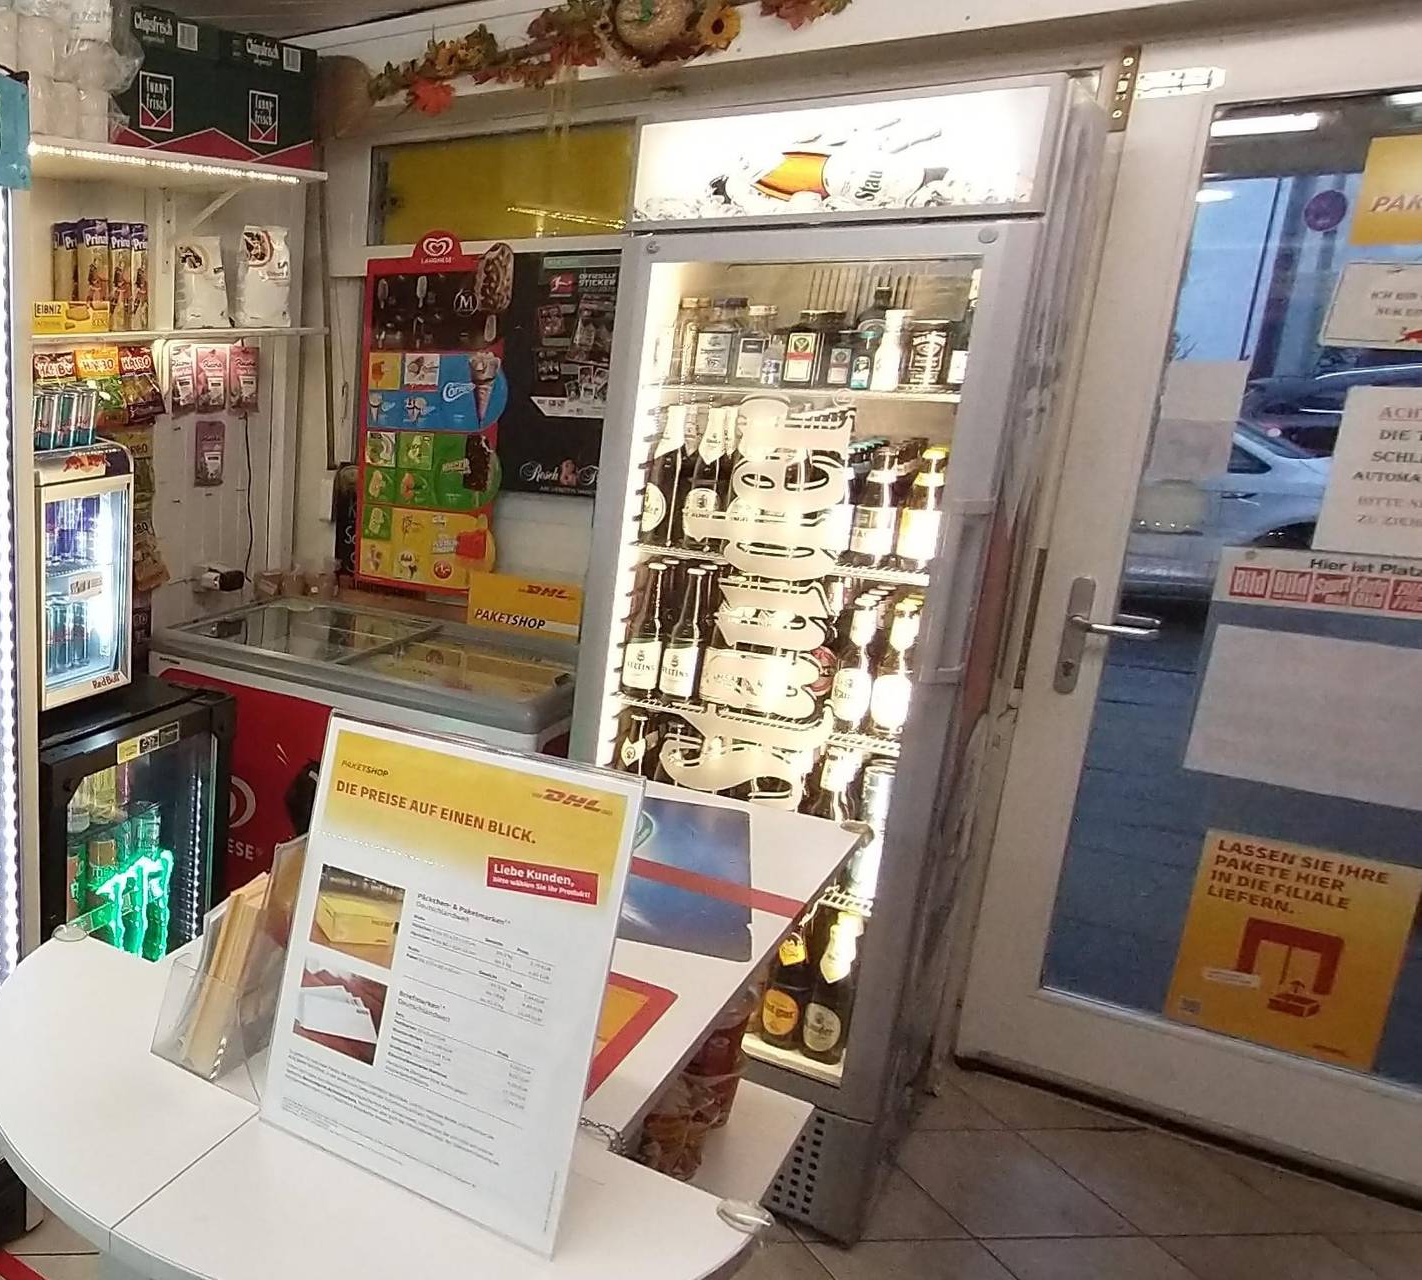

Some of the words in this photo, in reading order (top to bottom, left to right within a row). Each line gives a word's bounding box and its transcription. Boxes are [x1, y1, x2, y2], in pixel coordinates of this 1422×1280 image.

[134, 11, 173, 36] Chipsfrisch
[854, 169, 884, 202] Stau
[578, 278, 617, 288] STICKER
[122, 355, 152, 369] HARIBO
[1379, 429, 1411, 441] DIE
[1352, 471, 1422, 483] AUTOMA
[1310, 558, 1347, 571] Hier
[1352, 561, 1375, 573] ist
[524, 584, 568, 599] DHL
[474, 608, 546, 630] PAKETSHOP
[341, 759, 389, 778] PAKETSHOP
[336, 779, 359, 798] DIE
[360, 786, 408, 811] PREISE
[409, 799, 438, 818] AUF
[440, 808, 485, 831] EINEN
[487, 819, 537, 844] BLICK.
[541, 788, 604, 813] DHL
[1214, 854, 1290, 881] PAKETE
[1296, 870, 1346, 892] HIER
[1217, 838, 1295, 865] LASSEN
[1301, 856, 1335, 872] SIE
[1337, 863, 1390, 885] IHRE
[493, 863, 525, 878] Liebe
[526, 869, 575, 888] Kunden,
[535, 883, 547, 891] Sie
[547, 884, 558, 893] Ihr
[1209, 869, 1234, 885] IN
[1236, 875, 1269, 893] DIE
[1273, 883, 1351, 910] FILIALE
[1207, 885, 1295, 915] LIEFERN.
